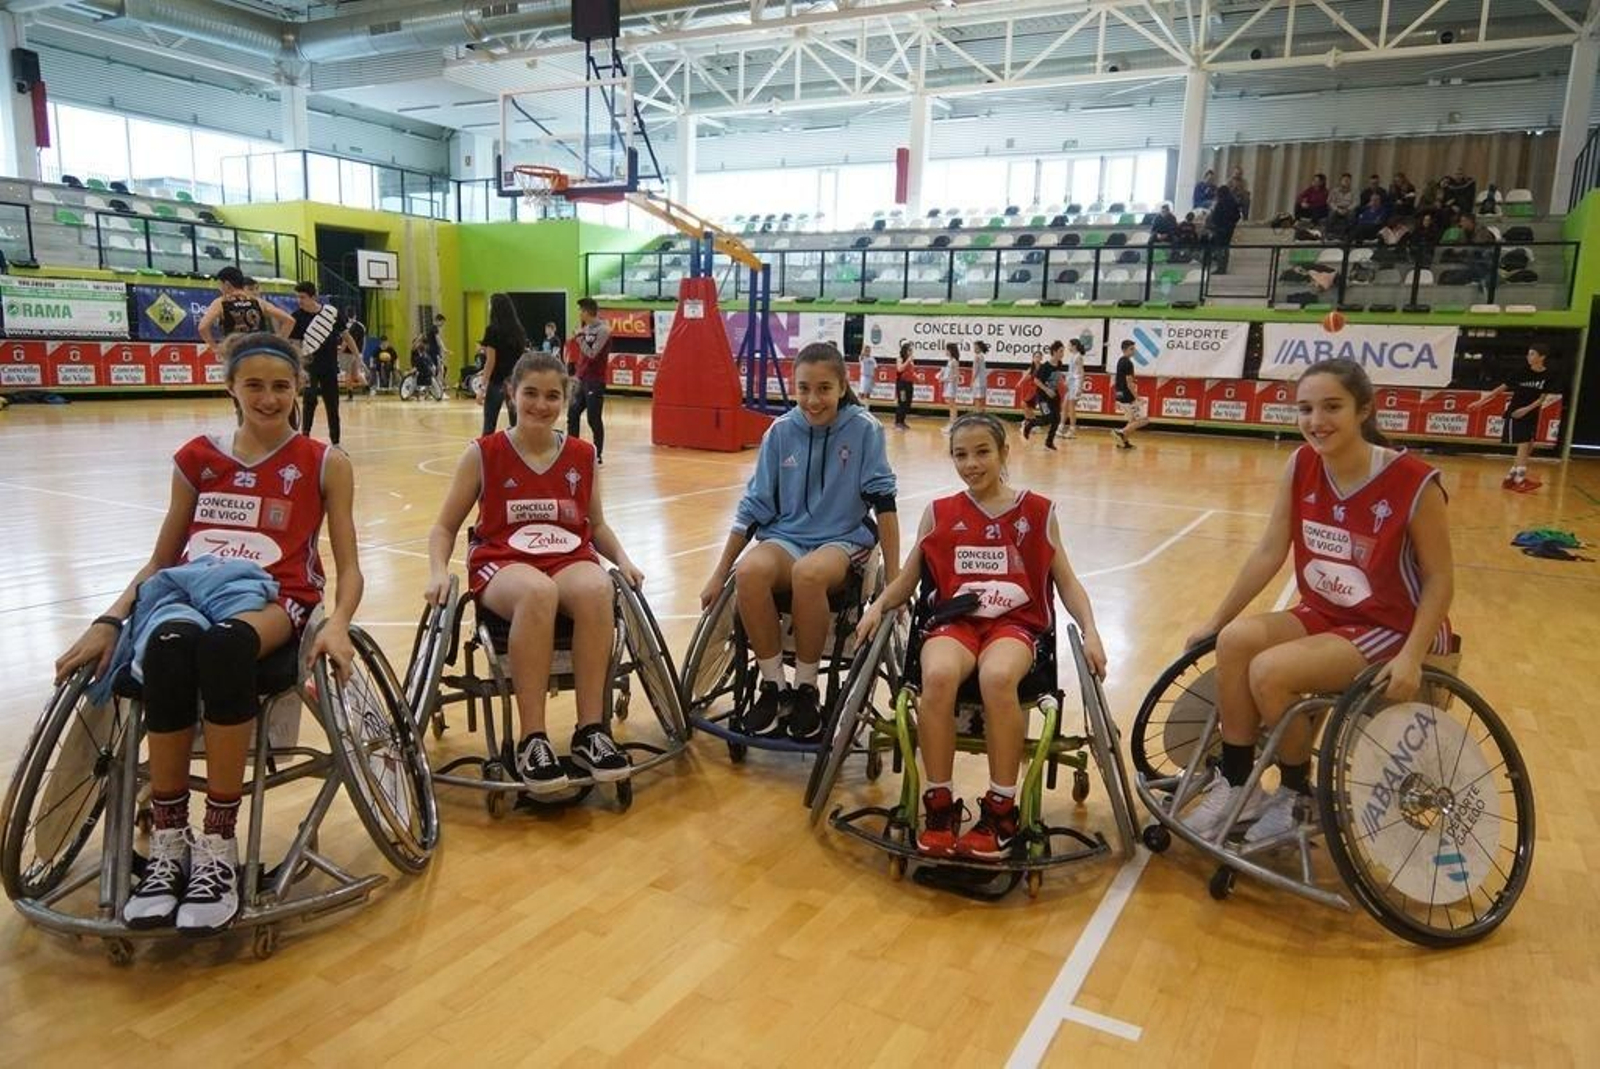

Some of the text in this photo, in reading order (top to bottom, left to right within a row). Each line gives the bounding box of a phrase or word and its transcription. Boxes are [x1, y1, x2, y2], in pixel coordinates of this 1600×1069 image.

[22, 303, 73, 318] RAMA
[913, 323, 1043, 337] CONCELLO DE VIGO
[1168, 328, 1229, 340] DEPORTE
[996, 340, 1052, 356] Deporte
[1166, 340, 1221, 351] GALEGO
[233, 471, 257, 487] 25
[198, 496, 255, 510] CONCELLO
[511, 503, 554, 512] CONCELLO
[200, 509, 247, 521] DE VIGO
[1317, 540, 1342, 553] VIGO
[957, 550, 1005, 559] CONCELLO
[961, 561, 999, 570] DE VIGO
[1446, 785, 1480, 838] DEPORTE
[1458, 799, 1485, 846] GALEGO
